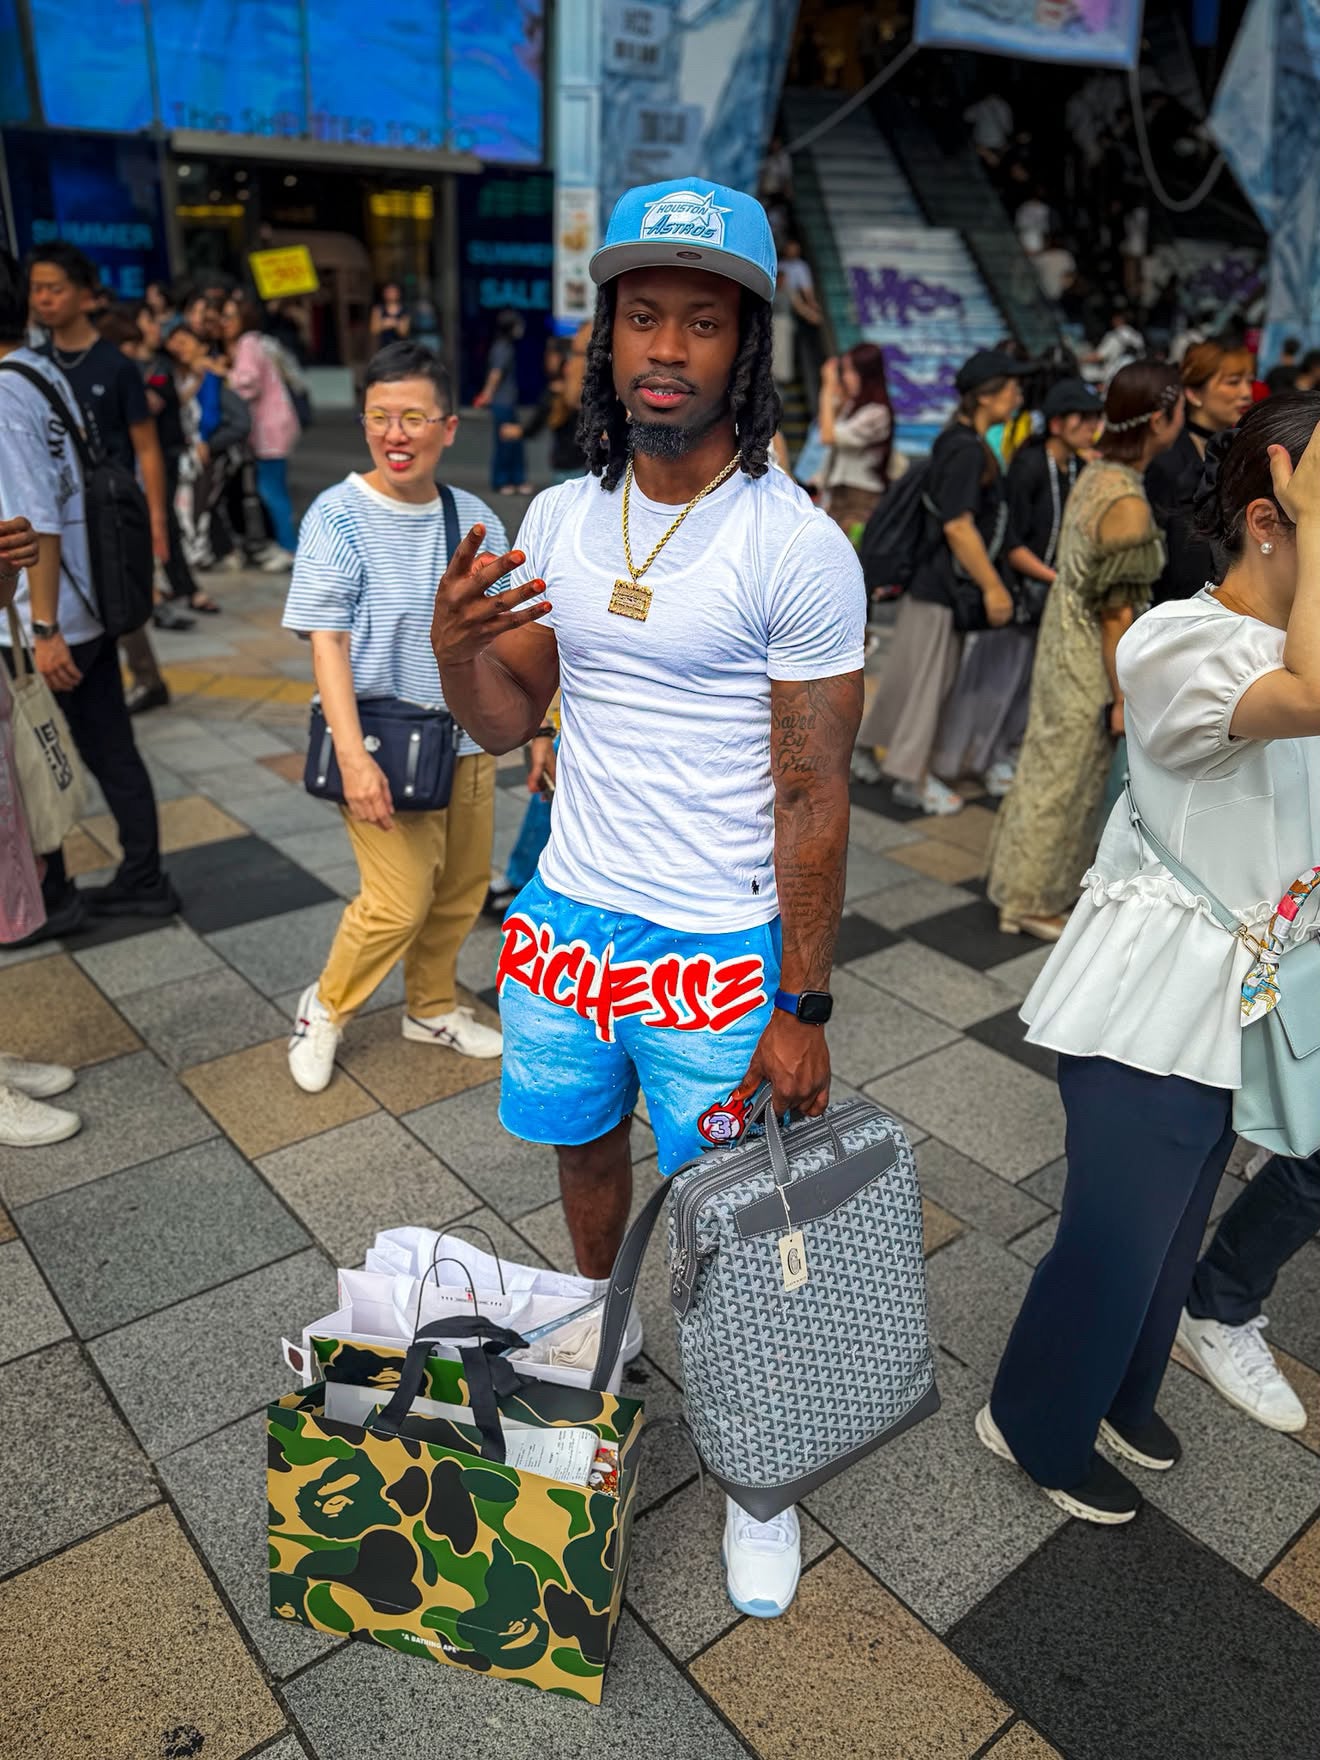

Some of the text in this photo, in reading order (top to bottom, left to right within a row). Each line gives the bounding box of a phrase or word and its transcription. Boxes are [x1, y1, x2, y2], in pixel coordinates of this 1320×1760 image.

[657, 204, 709, 215] HOUSTON
[31, 219, 153, 250] SUMMER
[647, 214, 717, 238] ASTROS
[479, 277, 551, 310] SALE
[773, 709, 817, 730] Saved
[779, 731, 809, 754] By
[774, 748, 831, 777] Grace
[708, 1114, 733, 1140] 3
[411, 1636, 442, 1649] BATHING
